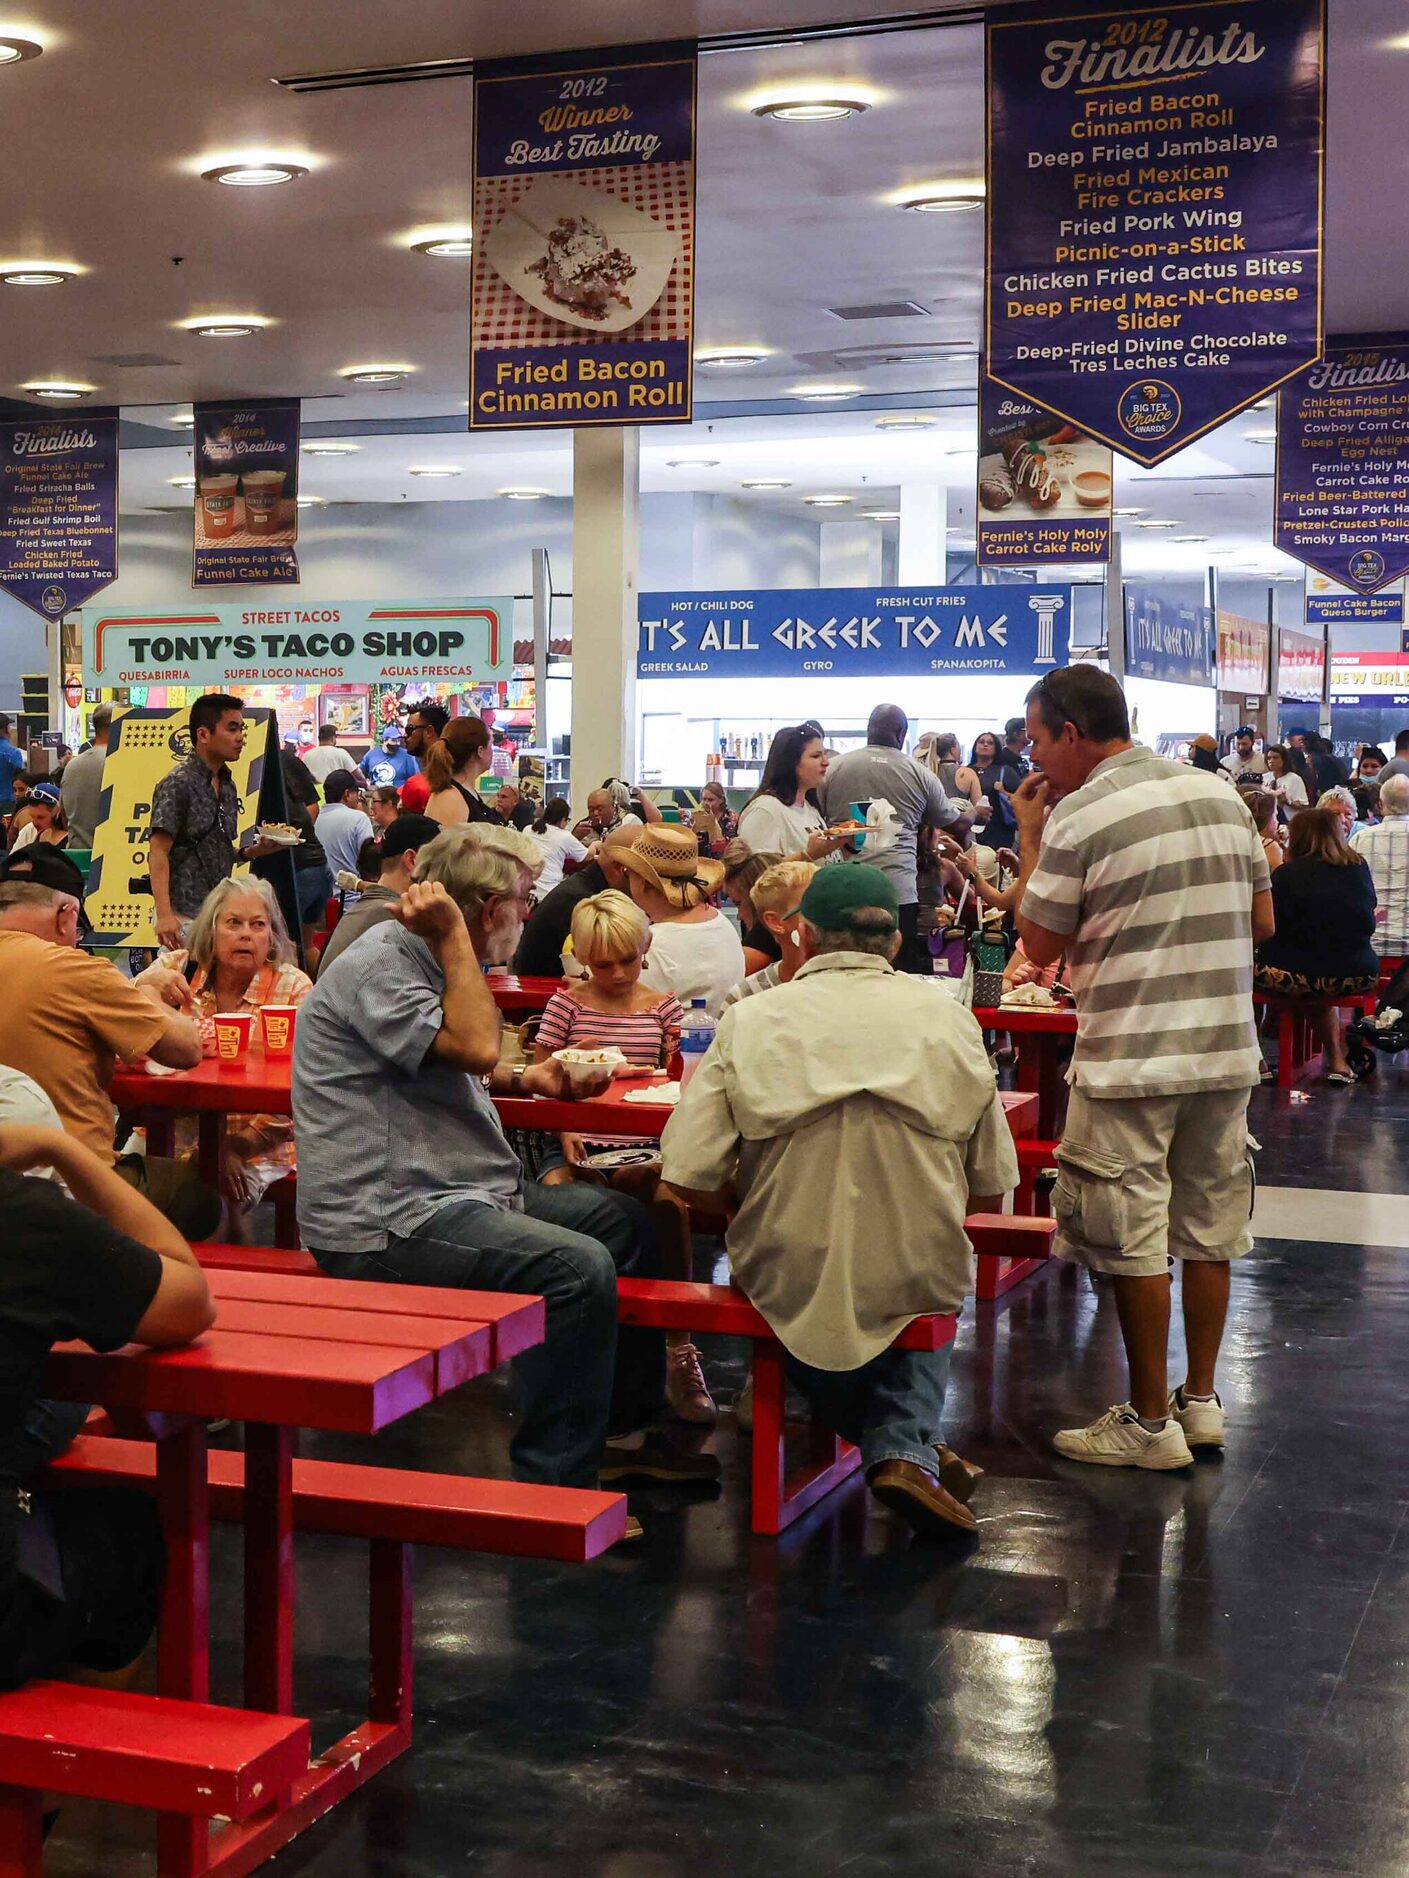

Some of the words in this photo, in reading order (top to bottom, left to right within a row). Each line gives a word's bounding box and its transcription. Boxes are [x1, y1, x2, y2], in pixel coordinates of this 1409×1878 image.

[1103, 17, 1168, 47] 2012
[1041, 22, 1266, 90] Finalists
[559, 77, 608, 99] 2012
[1085, 96, 1142, 118] Fried
[1150, 92, 1220, 111] Bacon
[538, 104, 633, 132] Winner
[1070, 115, 1183, 139] Cinnamon
[1191, 108, 1233, 129] Roll
[504, 139, 564, 165] Best
[568, 130, 661, 160] Tasting
[1028, 148, 1084, 169] Deep
[1092, 141, 1149, 164] Fried
[1157, 133, 1277, 158] Jambalaya
[1073, 168, 1130, 190] Fried
[1138, 163, 1229, 185] Mexican
[1078, 189, 1120, 210] Fire
[1128, 183, 1225, 207] Crackers
[1060, 215, 1117, 237] Fried
[1124, 212, 1175, 232] Pork
[1183, 209, 1243, 229] Wing
[1055, 233, 1246, 263] Picnic-on-a-Stick
[1004, 271, 1089, 294] Chicken
[1096, 263, 1154, 287] Fried
[1161, 259, 1238, 282] Cactus
[1245, 257, 1303, 276] Bites
[1006, 300, 1063, 320] Deep
[1069, 293, 1127, 314] Fried
[1134, 286, 1299, 309] Mac-N-Cheese
[1117, 311, 1182, 331] Slider
[1017, 339, 1119, 362] Deep-Fried
[1125, 336, 1185, 354] Divine
[1190, 332, 1287, 352] Chocolate
[1069, 358, 1107, 373] Tres
[1113, 354, 1178, 371] Leches
[1184, 350, 1231, 367] Cake
[496, 359, 568, 385] Fried
[578, 359, 665, 381] Bacon
[478, 389, 618, 413] Cinnamon
[628, 382, 683, 406] Roll
[1304, 422, 1355, 434] Cowboy
[1358, 421, 1389, 431] Corn
[13, 428, 96, 454] Finalists
[234, 440, 287, 454] Creative
[1312, 462, 1361, 474] Fernie's
[1364, 460, 1393, 473] Holy
[1316, 476, 1355, 487] Carrot
[1359, 474, 1391, 486] Cake
[1299, 505, 1329, 516] Lone
[1332, 504, 1358, 515] Star
[1362, 503, 1391, 514] Pork
[8, 517, 30, 525] Fried
[33, 516, 50, 525] Gulf
[52, 516, 82, 526] Shrimp
[84, 515, 101, 523] Boil
[982, 530, 1034, 542] Fernie's
[1039, 530, 1070, 543] Holy
[1074, 528, 1108, 541] Moly
[1293, 534, 1336, 546] Smoky
[1339, 533, 1378, 544] Bacon
[986, 543, 1029, 555] Carrot
[1033, 542, 1067, 554] Cake
[1071, 541, 1103, 554] Roly
[31, 571, 64, 580] Twisted
[66, 570, 90, 579] Texas
[92, 570, 112, 578] Taco
[197, 568, 236, 580] Funnel
[240, 567, 269, 578] Cake
[671, 602, 692, 611] HOT
[694, 602, 700, 611] /
[701, 601, 727, 610] CHILI
[730, 601, 753, 610] DOG
[876, 597, 910, 608] FRESH
[912, 597, 934, 607] CUT
[936, 596, 966, 607] FRIES
[1308, 599, 1341, 608] Funnel
[1344, 599, 1368, 608] Cake
[1370, 598, 1401, 608] Bacon
[242, 611, 291, 625] STREET
[294, 610, 340, 623] TACOS
[1320, 607, 1352, 618] Queso
[1354, 607, 1388, 618] Burger
[699, 618, 759, 651] ALL
[771, 615, 882, 650] GREEK
[895, 615, 942, 648] TO
[954, 614, 1008, 648] ME
[128, 635, 256, 663] TONY'S
[261, 632, 354, 658] TACO
[362, 631, 465, 657] SHOP
[380, 665, 419, 676] AGUAS
[421, 665, 473, 676] FRESCAS
[640, 662, 673, 672] GREEK
[675, 662, 708, 672] SALAD
[803, 661, 833, 670] GYRO
[930, 658, 1006, 669] SPANAKOPITA
[119, 669, 190, 682] QUESABIRRIA
[224, 669, 258, 679] SUPER
[262, 668, 292, 679] LOCO
[296, 667, 344, 678] NACHOS
